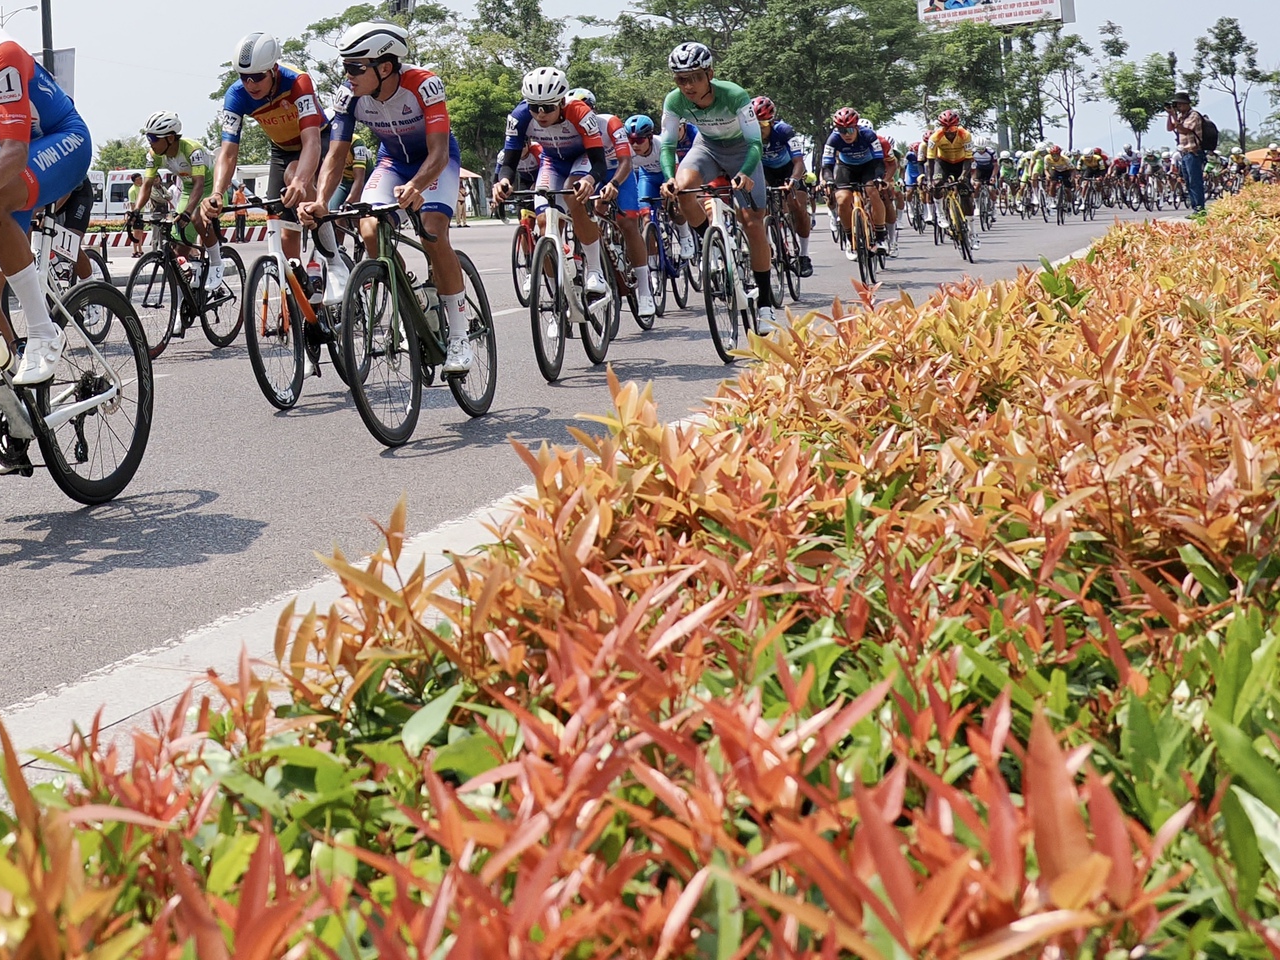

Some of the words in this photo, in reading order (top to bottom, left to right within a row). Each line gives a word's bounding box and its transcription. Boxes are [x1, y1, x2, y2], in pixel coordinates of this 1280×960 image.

[421, 80, 444, 98] 104
[32, 146, 61, 172] VĨNH
[60, 231, 72, 252] 11
